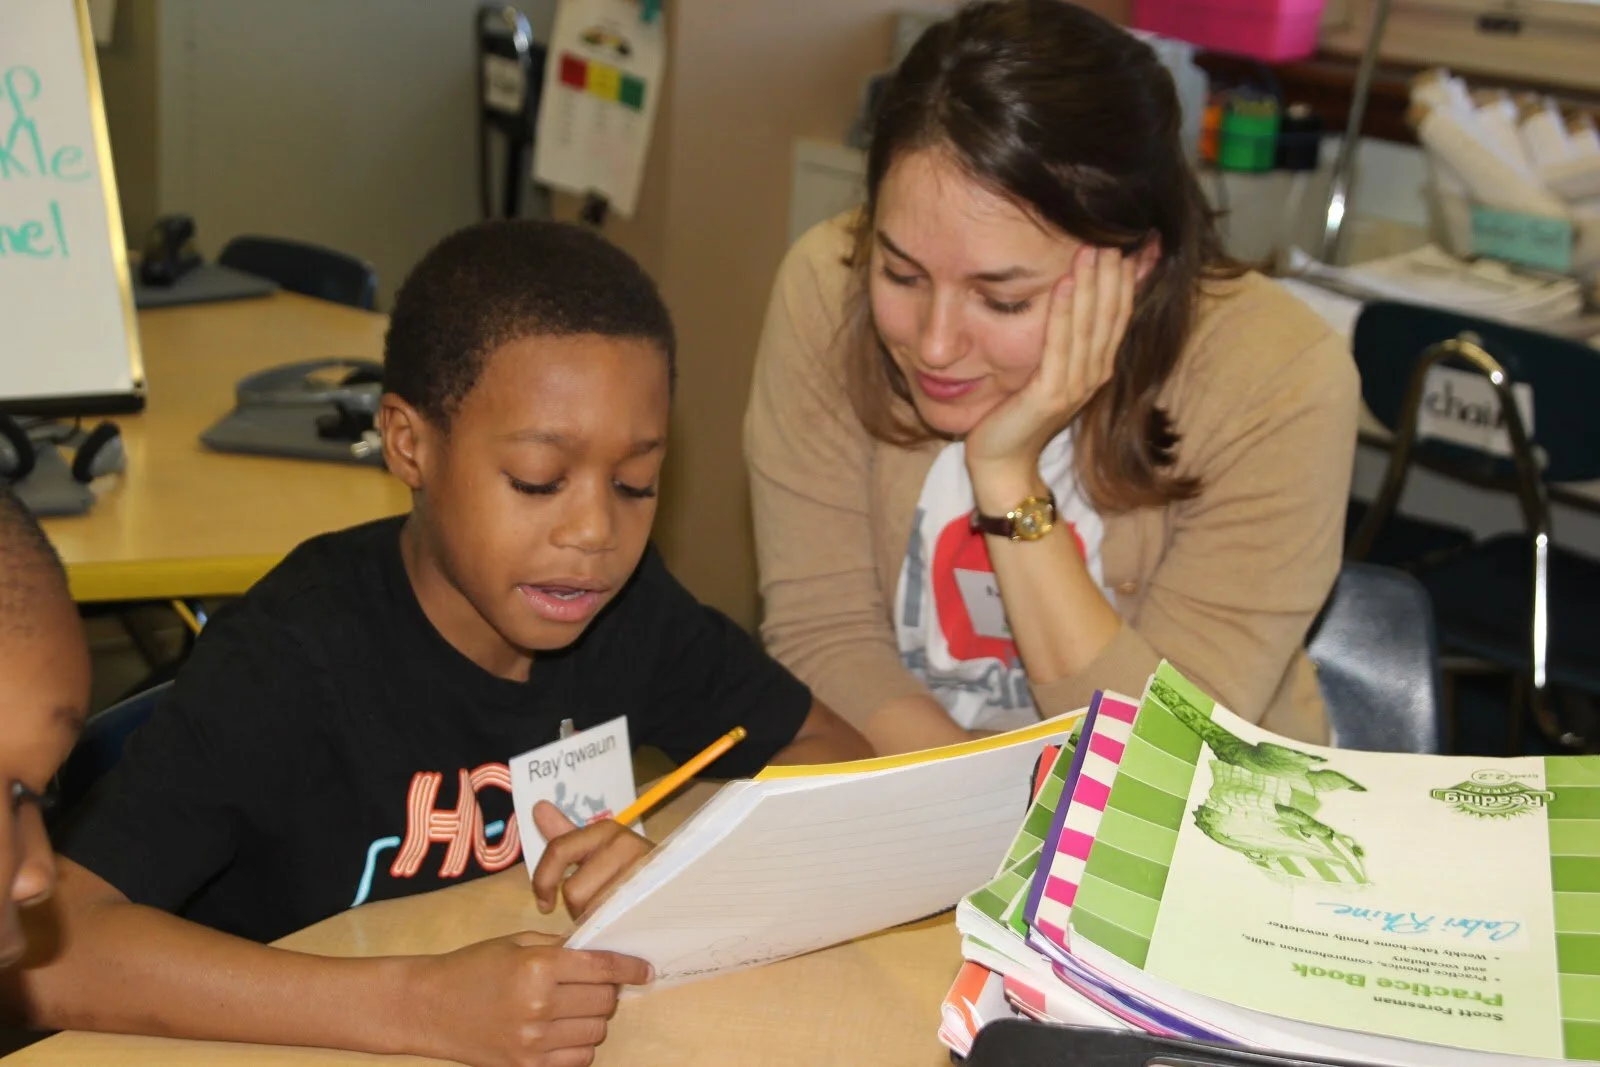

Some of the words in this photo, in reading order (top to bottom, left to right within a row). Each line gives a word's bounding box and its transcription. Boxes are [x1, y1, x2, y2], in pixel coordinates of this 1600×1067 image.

[528, 734, 616, 783] Ray'qwaun
[1444, 791, 1544, 807] Reading
[1267, 920, 1329, 937] newsletter
[1241, 933, 1276, 946] skills,
[1333, 934, 1369, 946] family
[1279, 943, 1373, 965] comprehension
[1373, 940, 1439, 955] take-home
[1442, 949, 1487, 961] Weekly
[1377, 960, 1430, 974] phonics,
[1392, 955, 1460, 970] vocabulary
[1290, 961, 1366, 987] Book
[1433, 969, 1487, 982] Practice
[1376, 977, 1504, 1007] Practice
[1373, 996, 1453, 1015] Foresman
[1458, 1008, 1504, 1021] Scott
